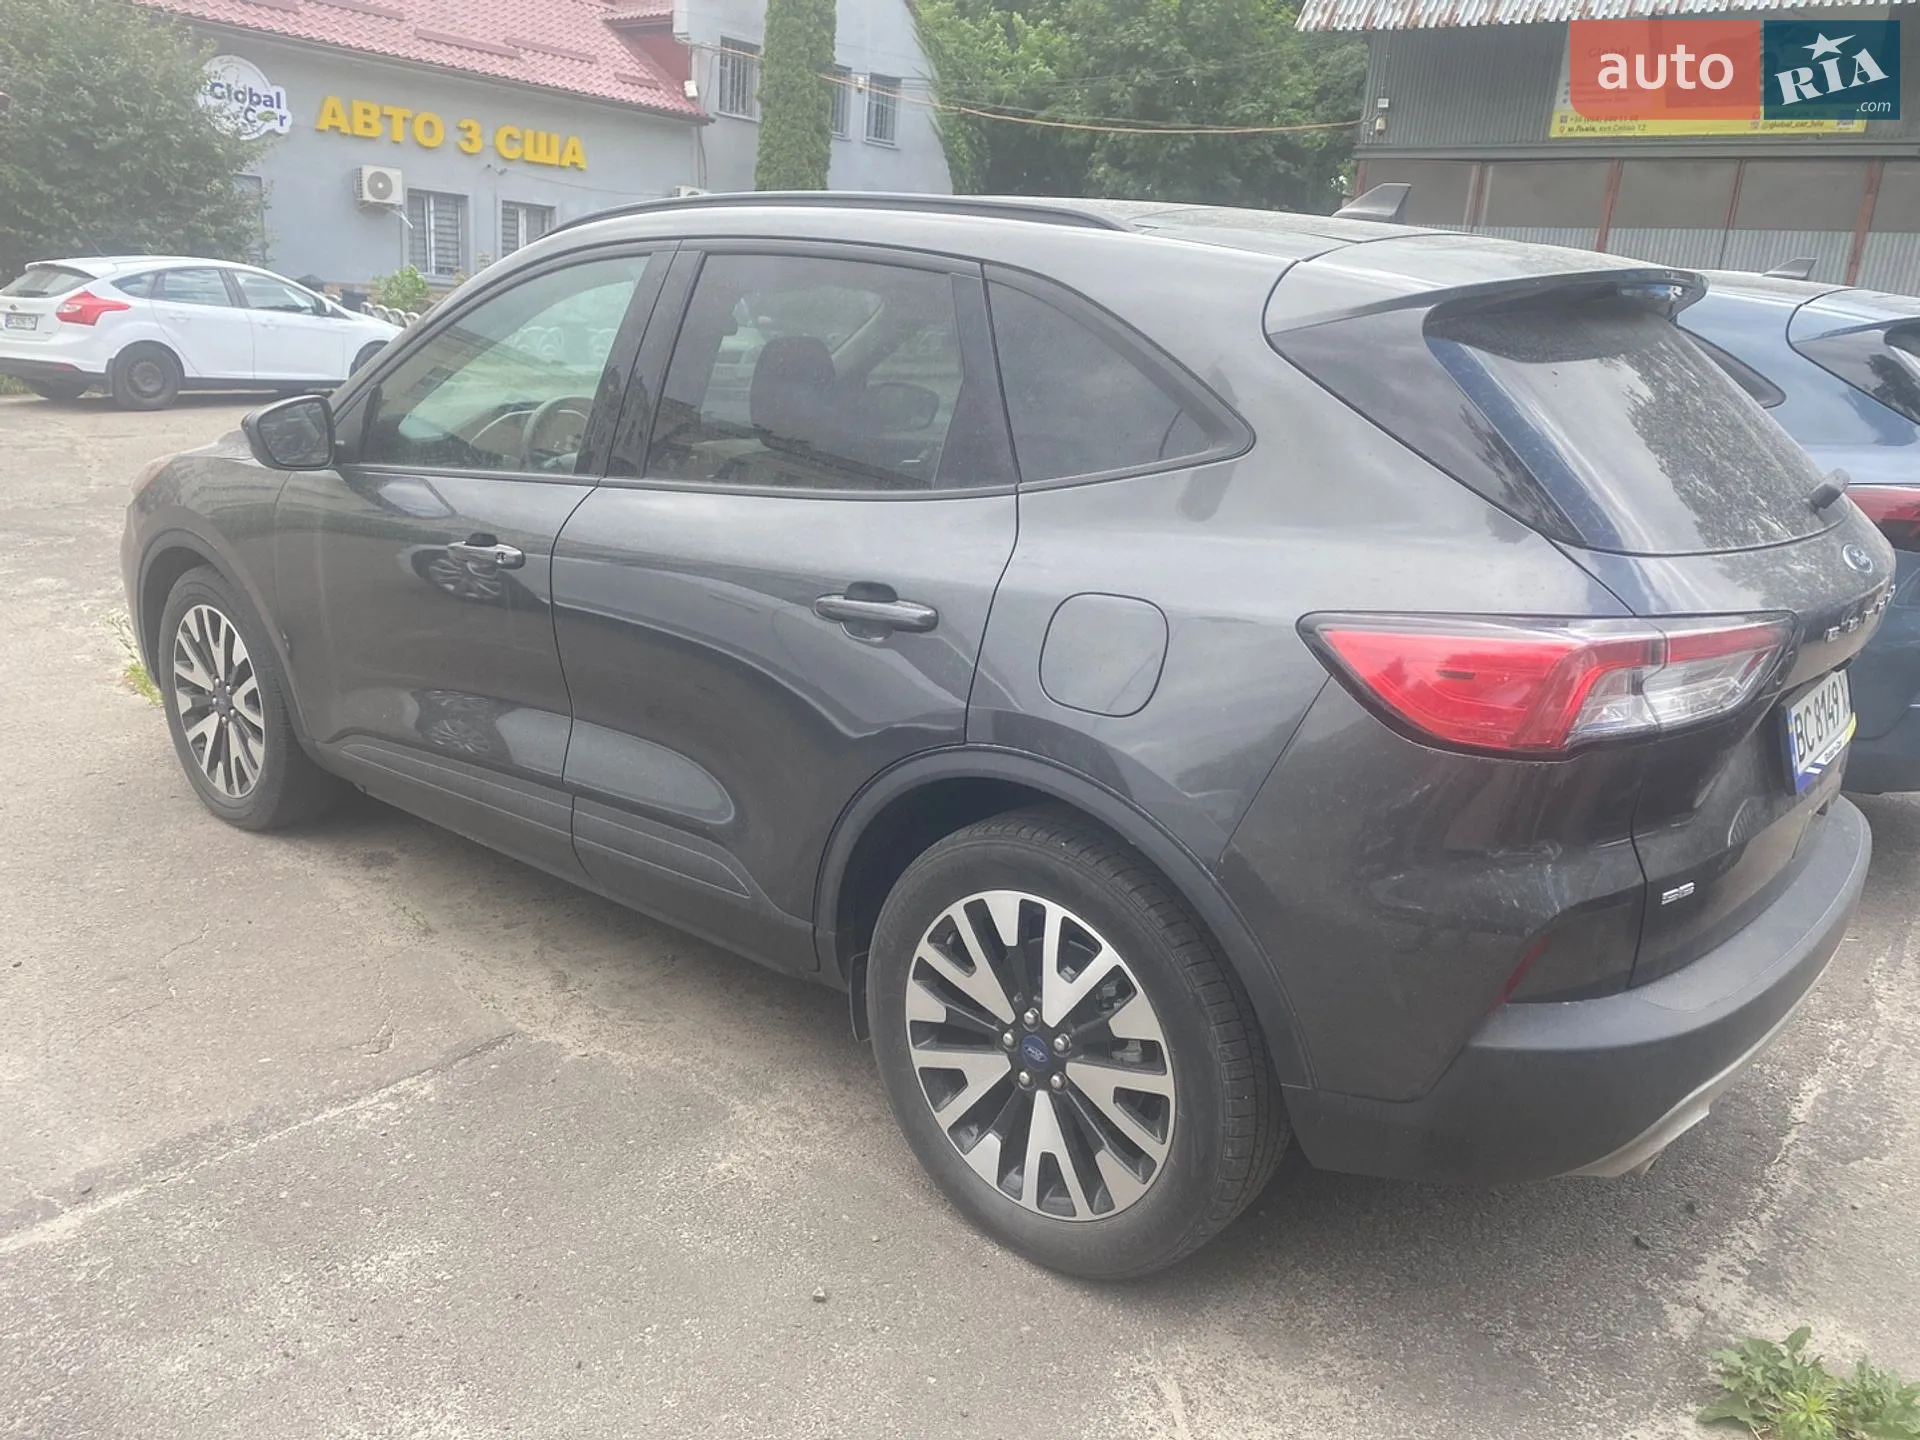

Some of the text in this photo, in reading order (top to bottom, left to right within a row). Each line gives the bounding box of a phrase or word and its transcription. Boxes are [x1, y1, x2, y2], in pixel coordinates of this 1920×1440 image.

[315, 95, 445, 149] АВТО
[494, 124, 588, 172] США
[1795, 705, 1815, 763] BC
[1814, 681, 1840, 743] 8149
